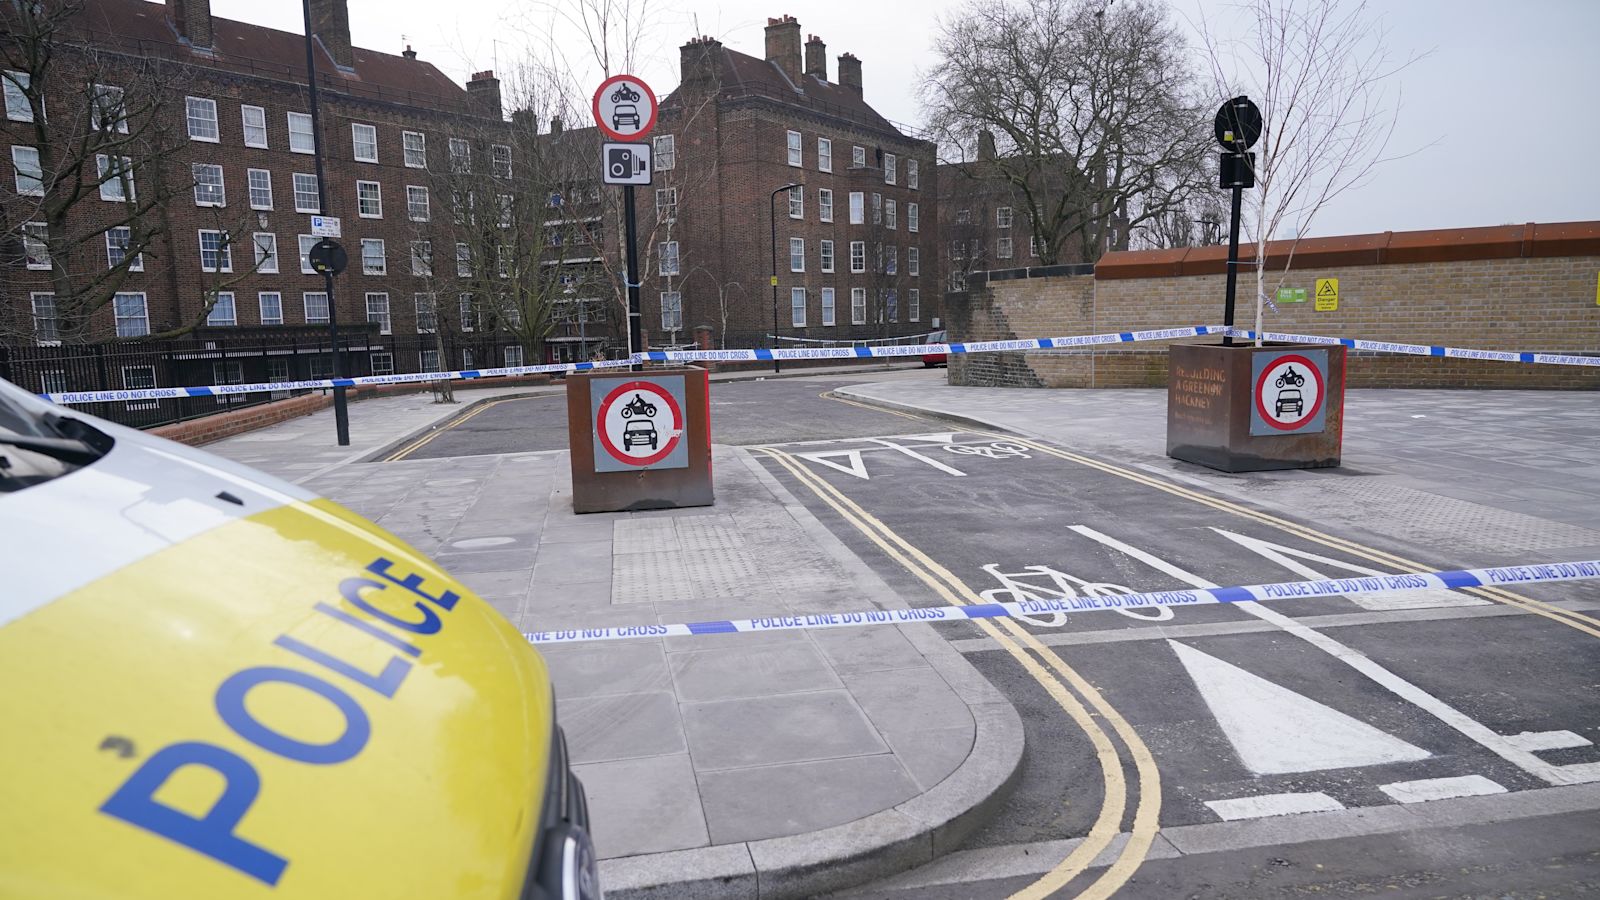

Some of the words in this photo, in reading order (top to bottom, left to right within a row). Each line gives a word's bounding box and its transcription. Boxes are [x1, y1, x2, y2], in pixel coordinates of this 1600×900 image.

[1176, 380, 1181, 390] A
[1176, 394, 1210, 408] HACKNEY
[1486, 568, 1530, 582] POLICE
[1531, 566, 1558, 579] LINE
[1557, 564, 1576, 577] DO
[1572, 562, 1600, 576] NOT
[1263, 583, 1312, 597] POLICE
[1312, 580, 1339, 594] LINE
[1342, 579, 1359, 592] DO
[1360, 577, 1386, 591] NOT
[1388, 575, 1428, 588] CROSS
[1019, 600, 1070, 613] POLICE
[1071, 597, 1101, 609] LINE
[1105, 595, 1122, 607] DO
[1125, 593, 1151, 606] NOT
[1152, 591, 1197, 604] CROSS
[751, 617, 802, 628] POLICE
[807, 613, 838, 625] LINE
[844, 611, 862, 623] DO
[867, 610, 893, 622] NOT
[899, 608, 945, 620] CROSS
[526, 632, 550, 640] INE
[555, 629, 576, 640] DO
[582, 628, 610, 639] NOT
[617, 625, 668, 636] CROSS
[97, 557, 461, 887] POLICE
